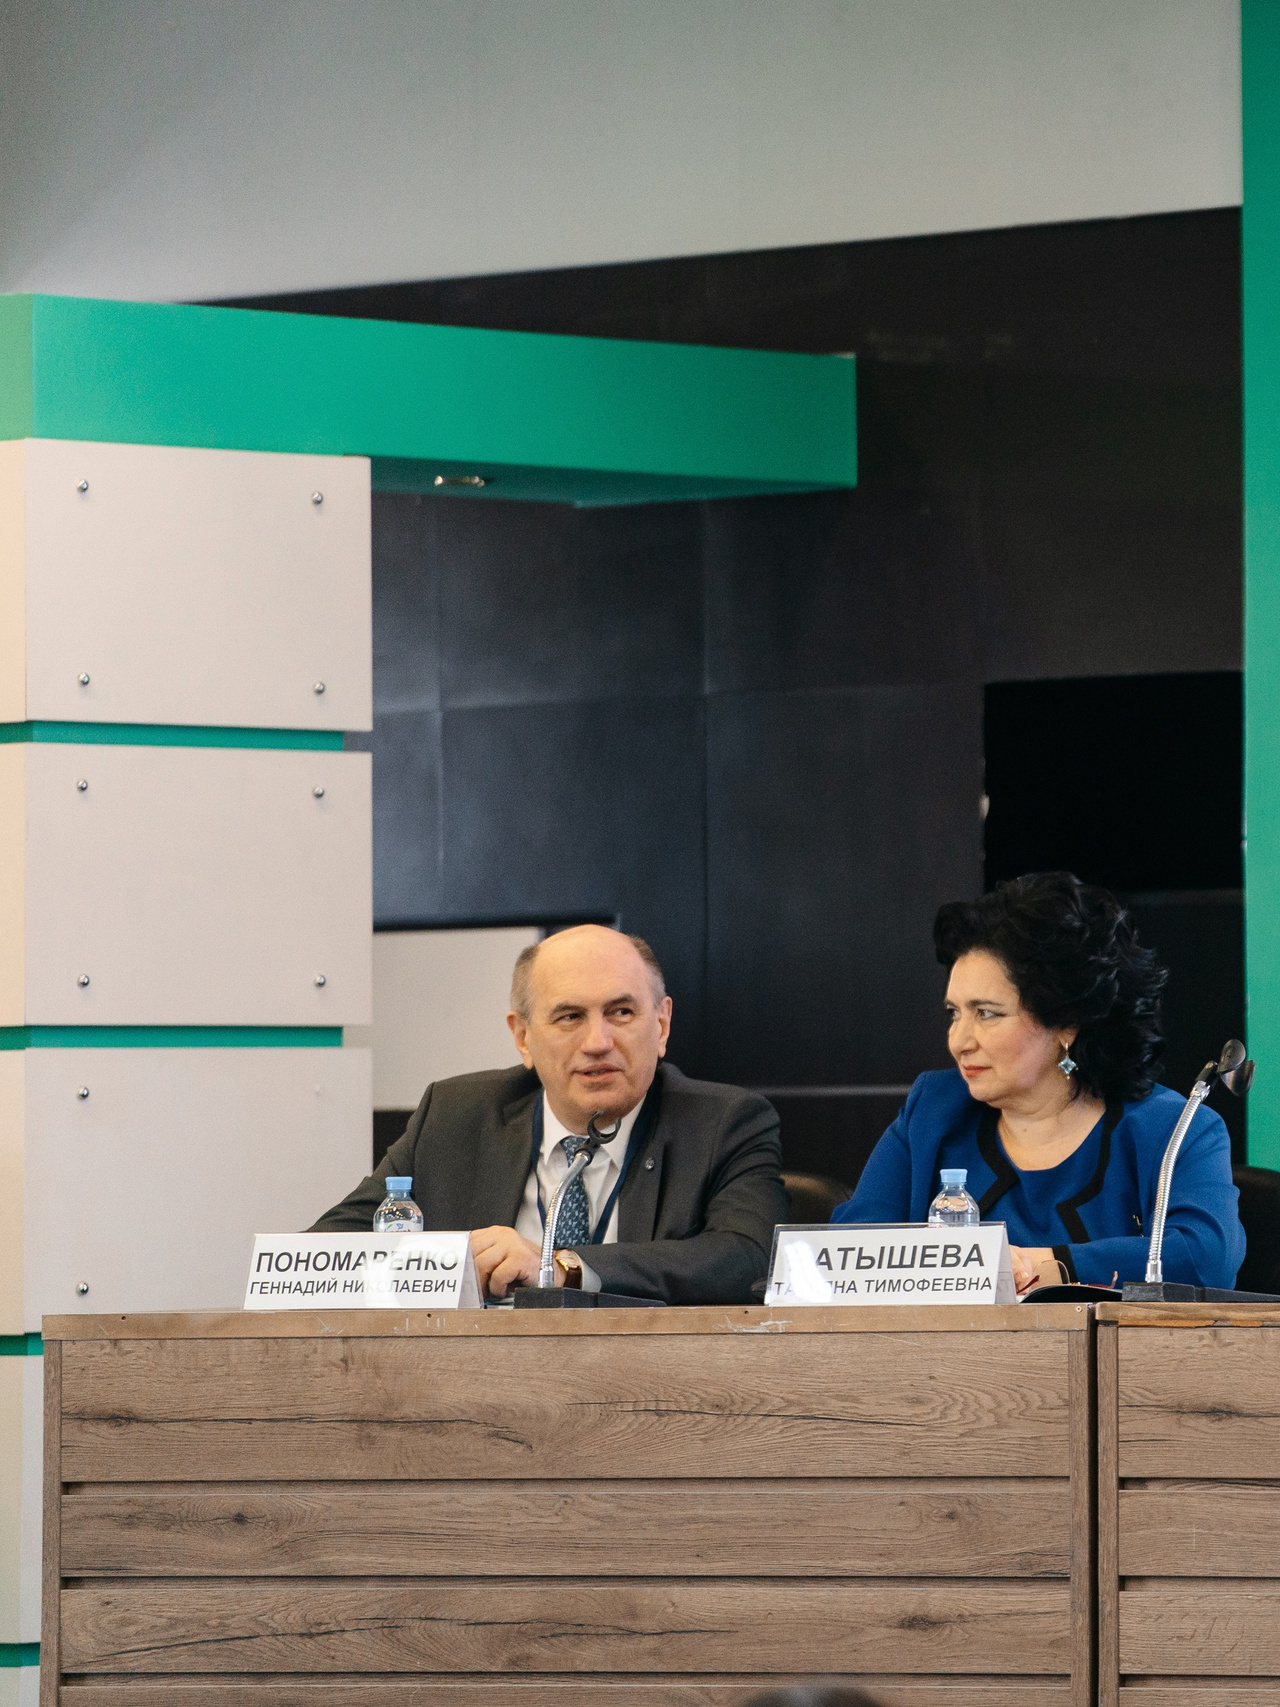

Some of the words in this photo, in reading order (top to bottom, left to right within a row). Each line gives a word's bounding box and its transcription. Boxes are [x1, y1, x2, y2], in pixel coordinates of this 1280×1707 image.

[812, 1243, 985, 1271] АТЫШЕВА
[249, 1277, 338, 1297] ГЕННАДИЙ
[864, 1276, 992, 1293] ТИМОФЕЕВНА
